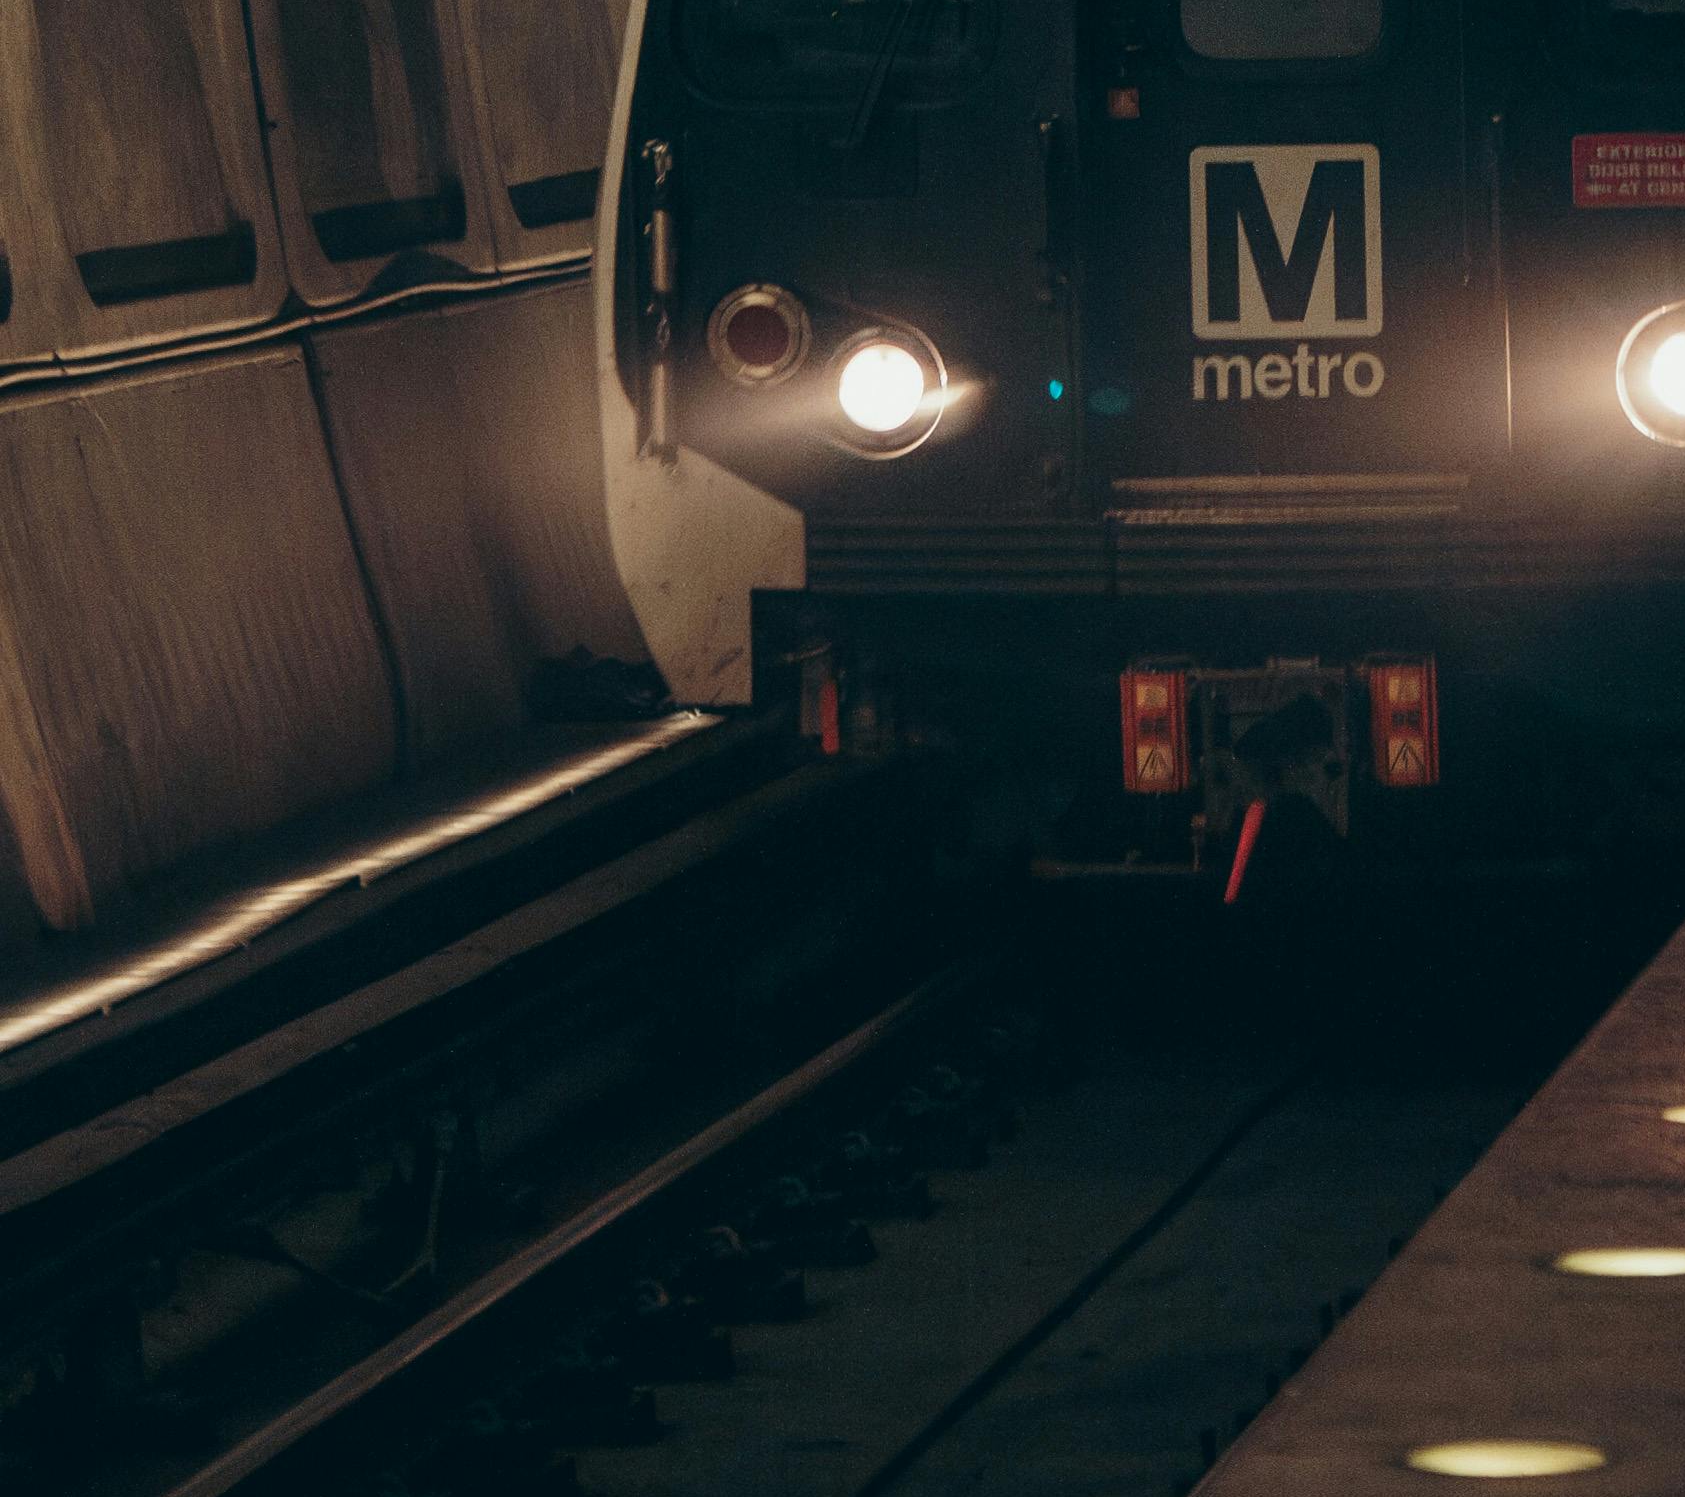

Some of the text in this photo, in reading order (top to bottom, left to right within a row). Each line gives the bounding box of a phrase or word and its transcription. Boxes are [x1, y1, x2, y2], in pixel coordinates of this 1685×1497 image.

[1589, 161, 1642, 177] DOOR
[1618, 181, 1640, 195] AT
[1204, 160, 1368, 323] M
[1192, 343, 1385, 401] metro
